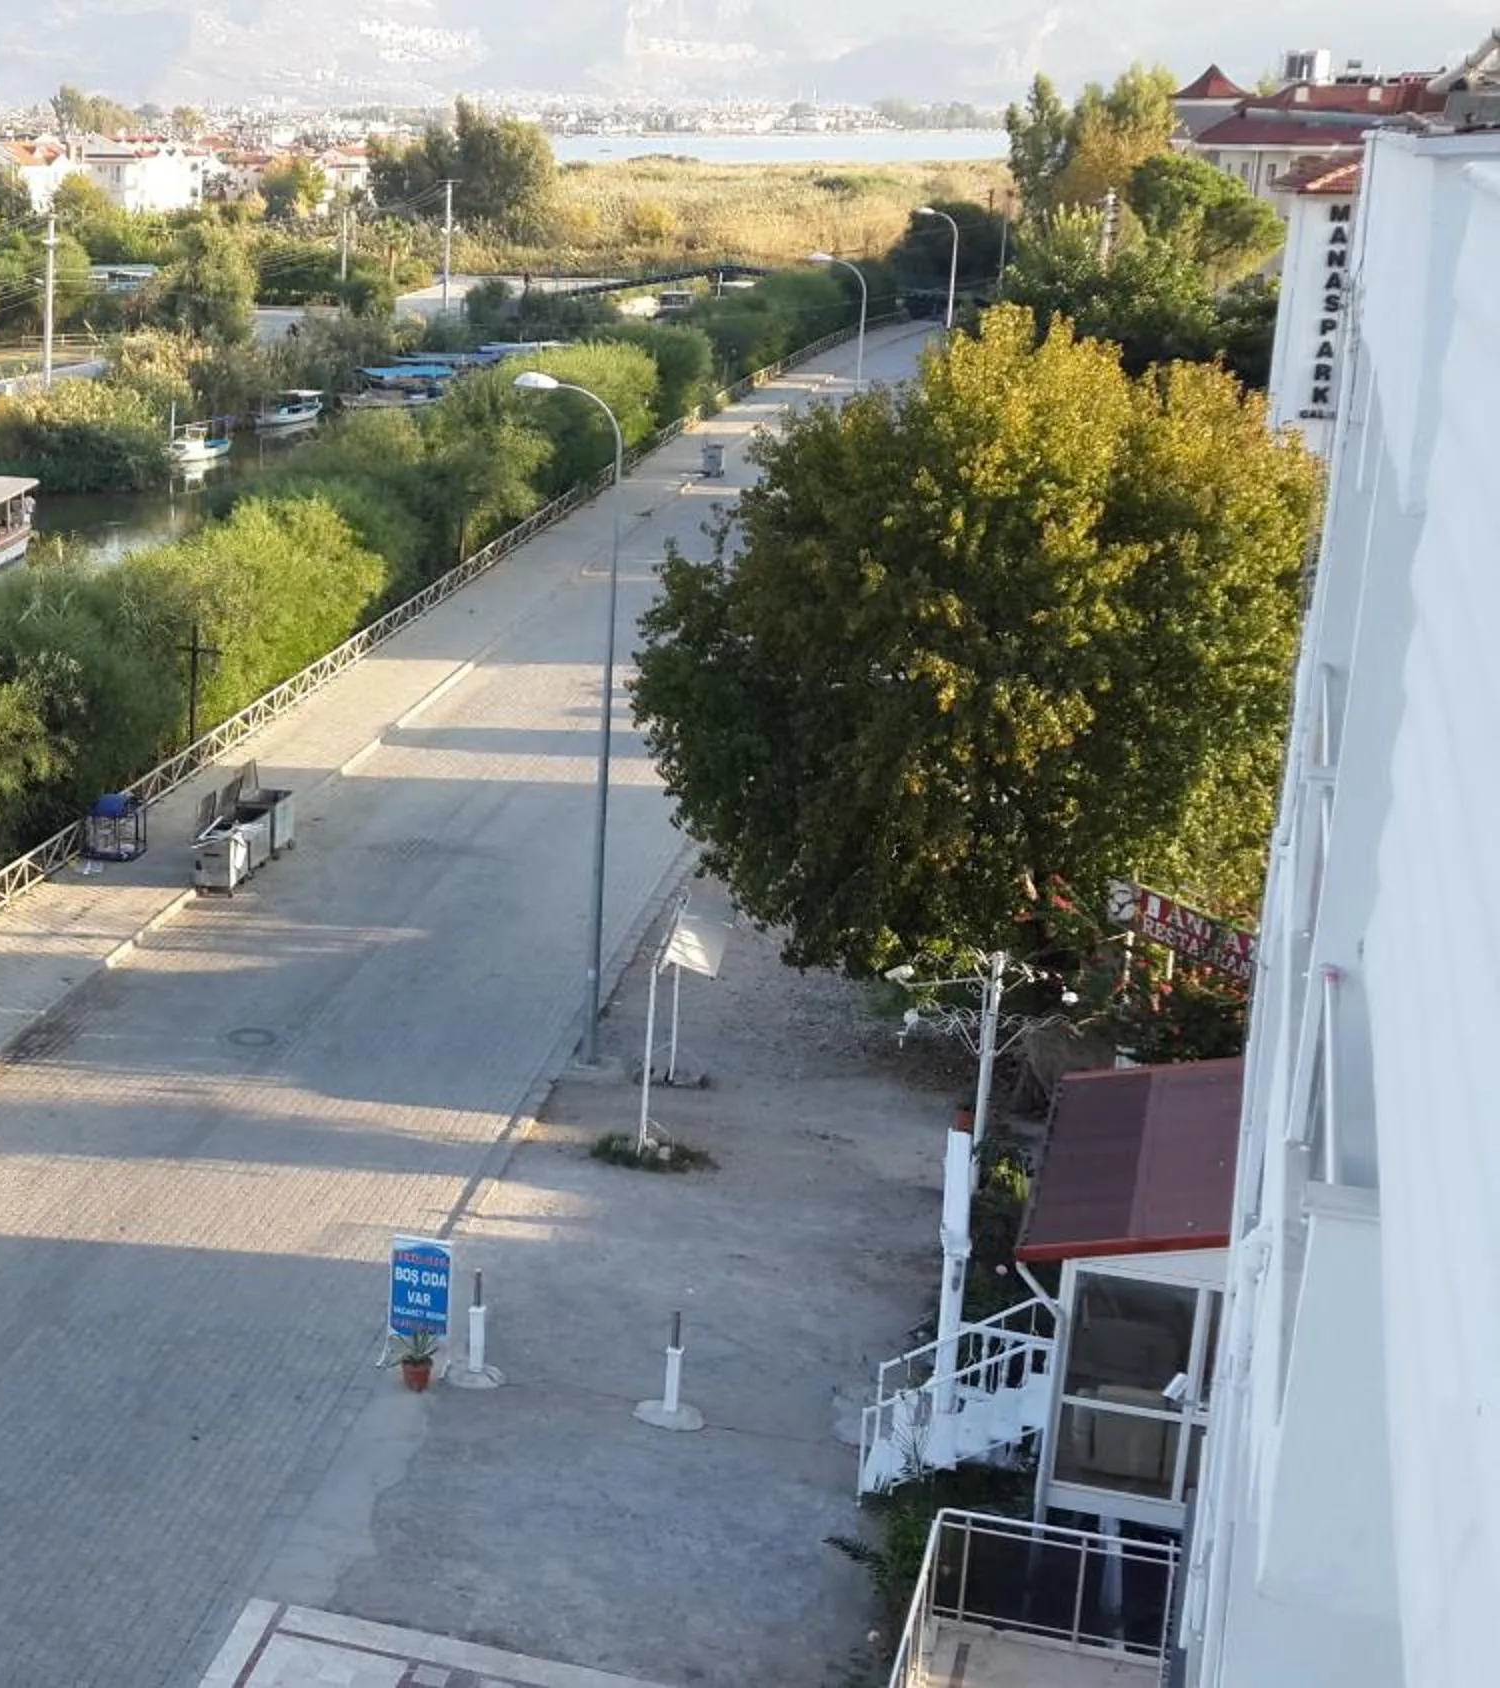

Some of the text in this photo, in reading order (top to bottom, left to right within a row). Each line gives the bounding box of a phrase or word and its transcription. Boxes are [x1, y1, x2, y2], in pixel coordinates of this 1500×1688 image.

[1312, 204, 1351, 404] MANASPARK
[394, 1267, 447, 1287] BOŞ ODA
[407, 1290, 431, 1306] VAR
